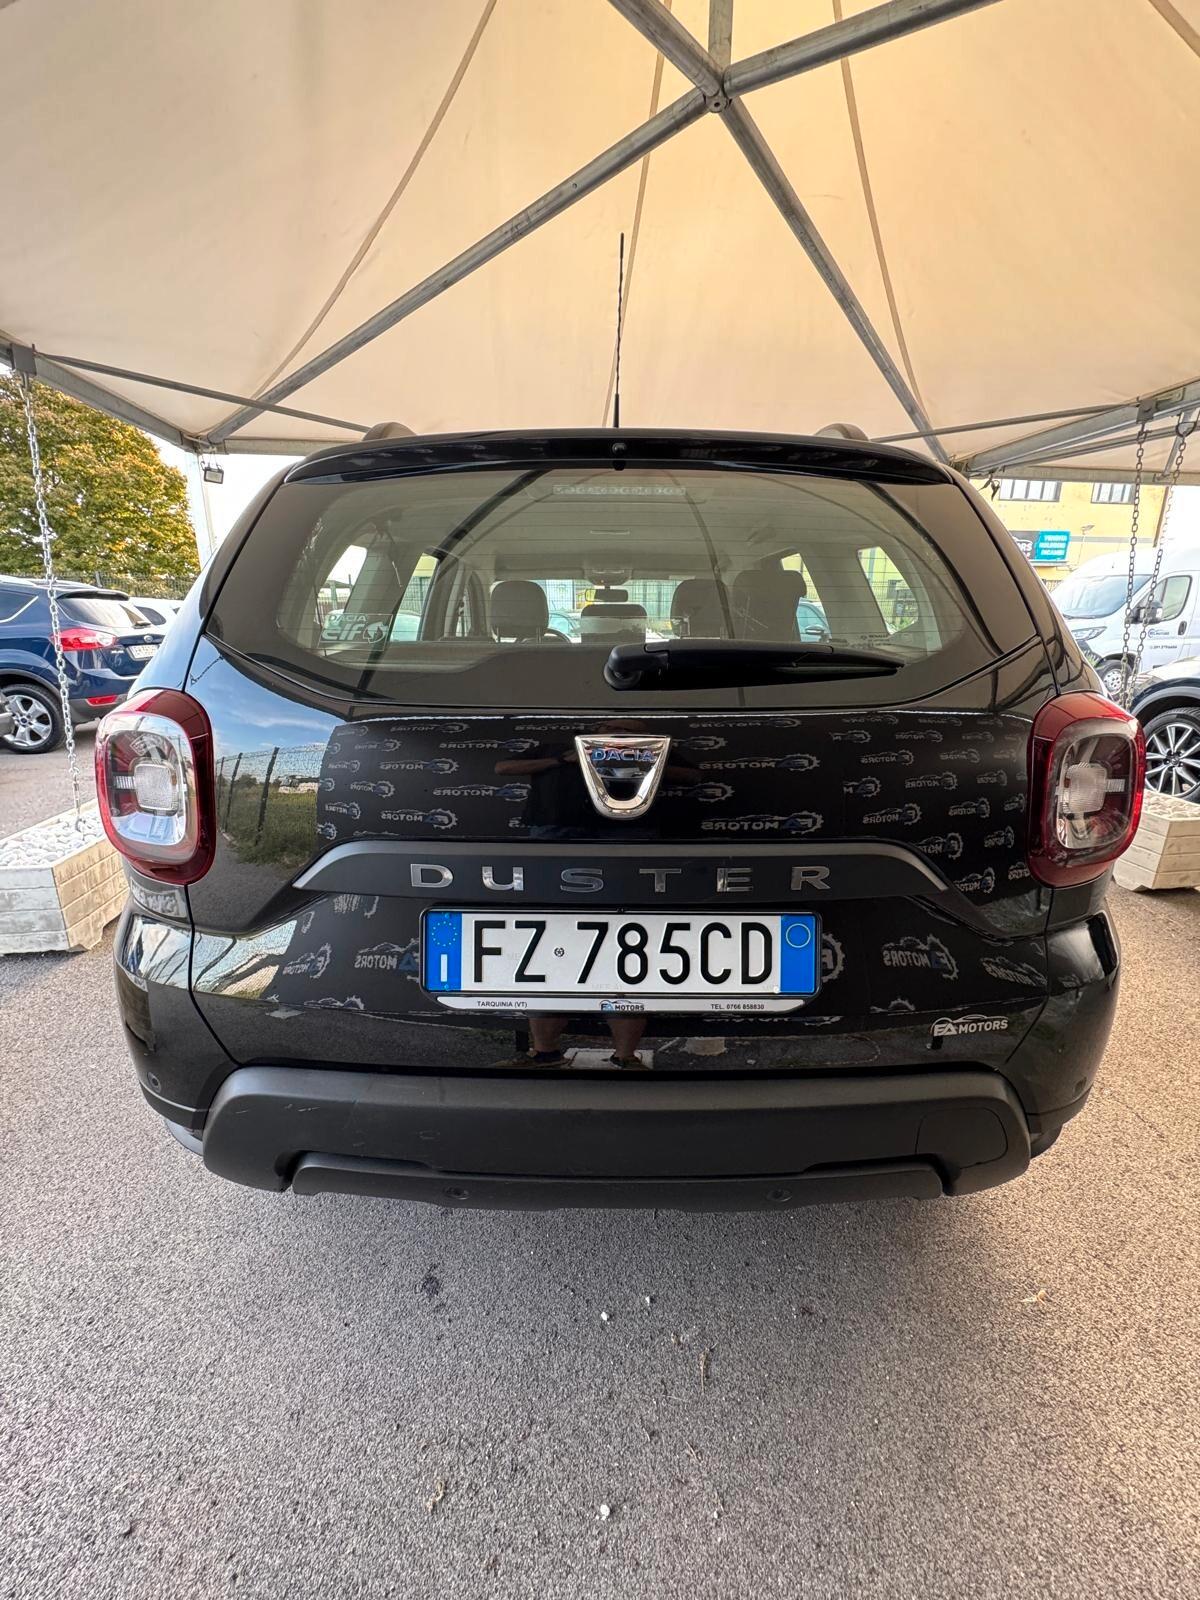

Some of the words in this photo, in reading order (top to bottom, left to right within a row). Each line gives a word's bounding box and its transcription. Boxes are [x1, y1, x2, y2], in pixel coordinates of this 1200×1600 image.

[328, 614, 367, 622] DACIA
[321, 623, 366, 641] elf
[591, 748, 654, 762] DACIA
[410, 862, 832, 893] DUSTER
[440, 953, 448, 983] I
[472, 918, 549, 985] FZ
[575, 919, 775, 987] 785CD
[477, 1000, 513, 1008] TARQUINIA
[514, 1000, 528, 1009] (VT)
[958, 1020, 1009, 1034] MOTORS
